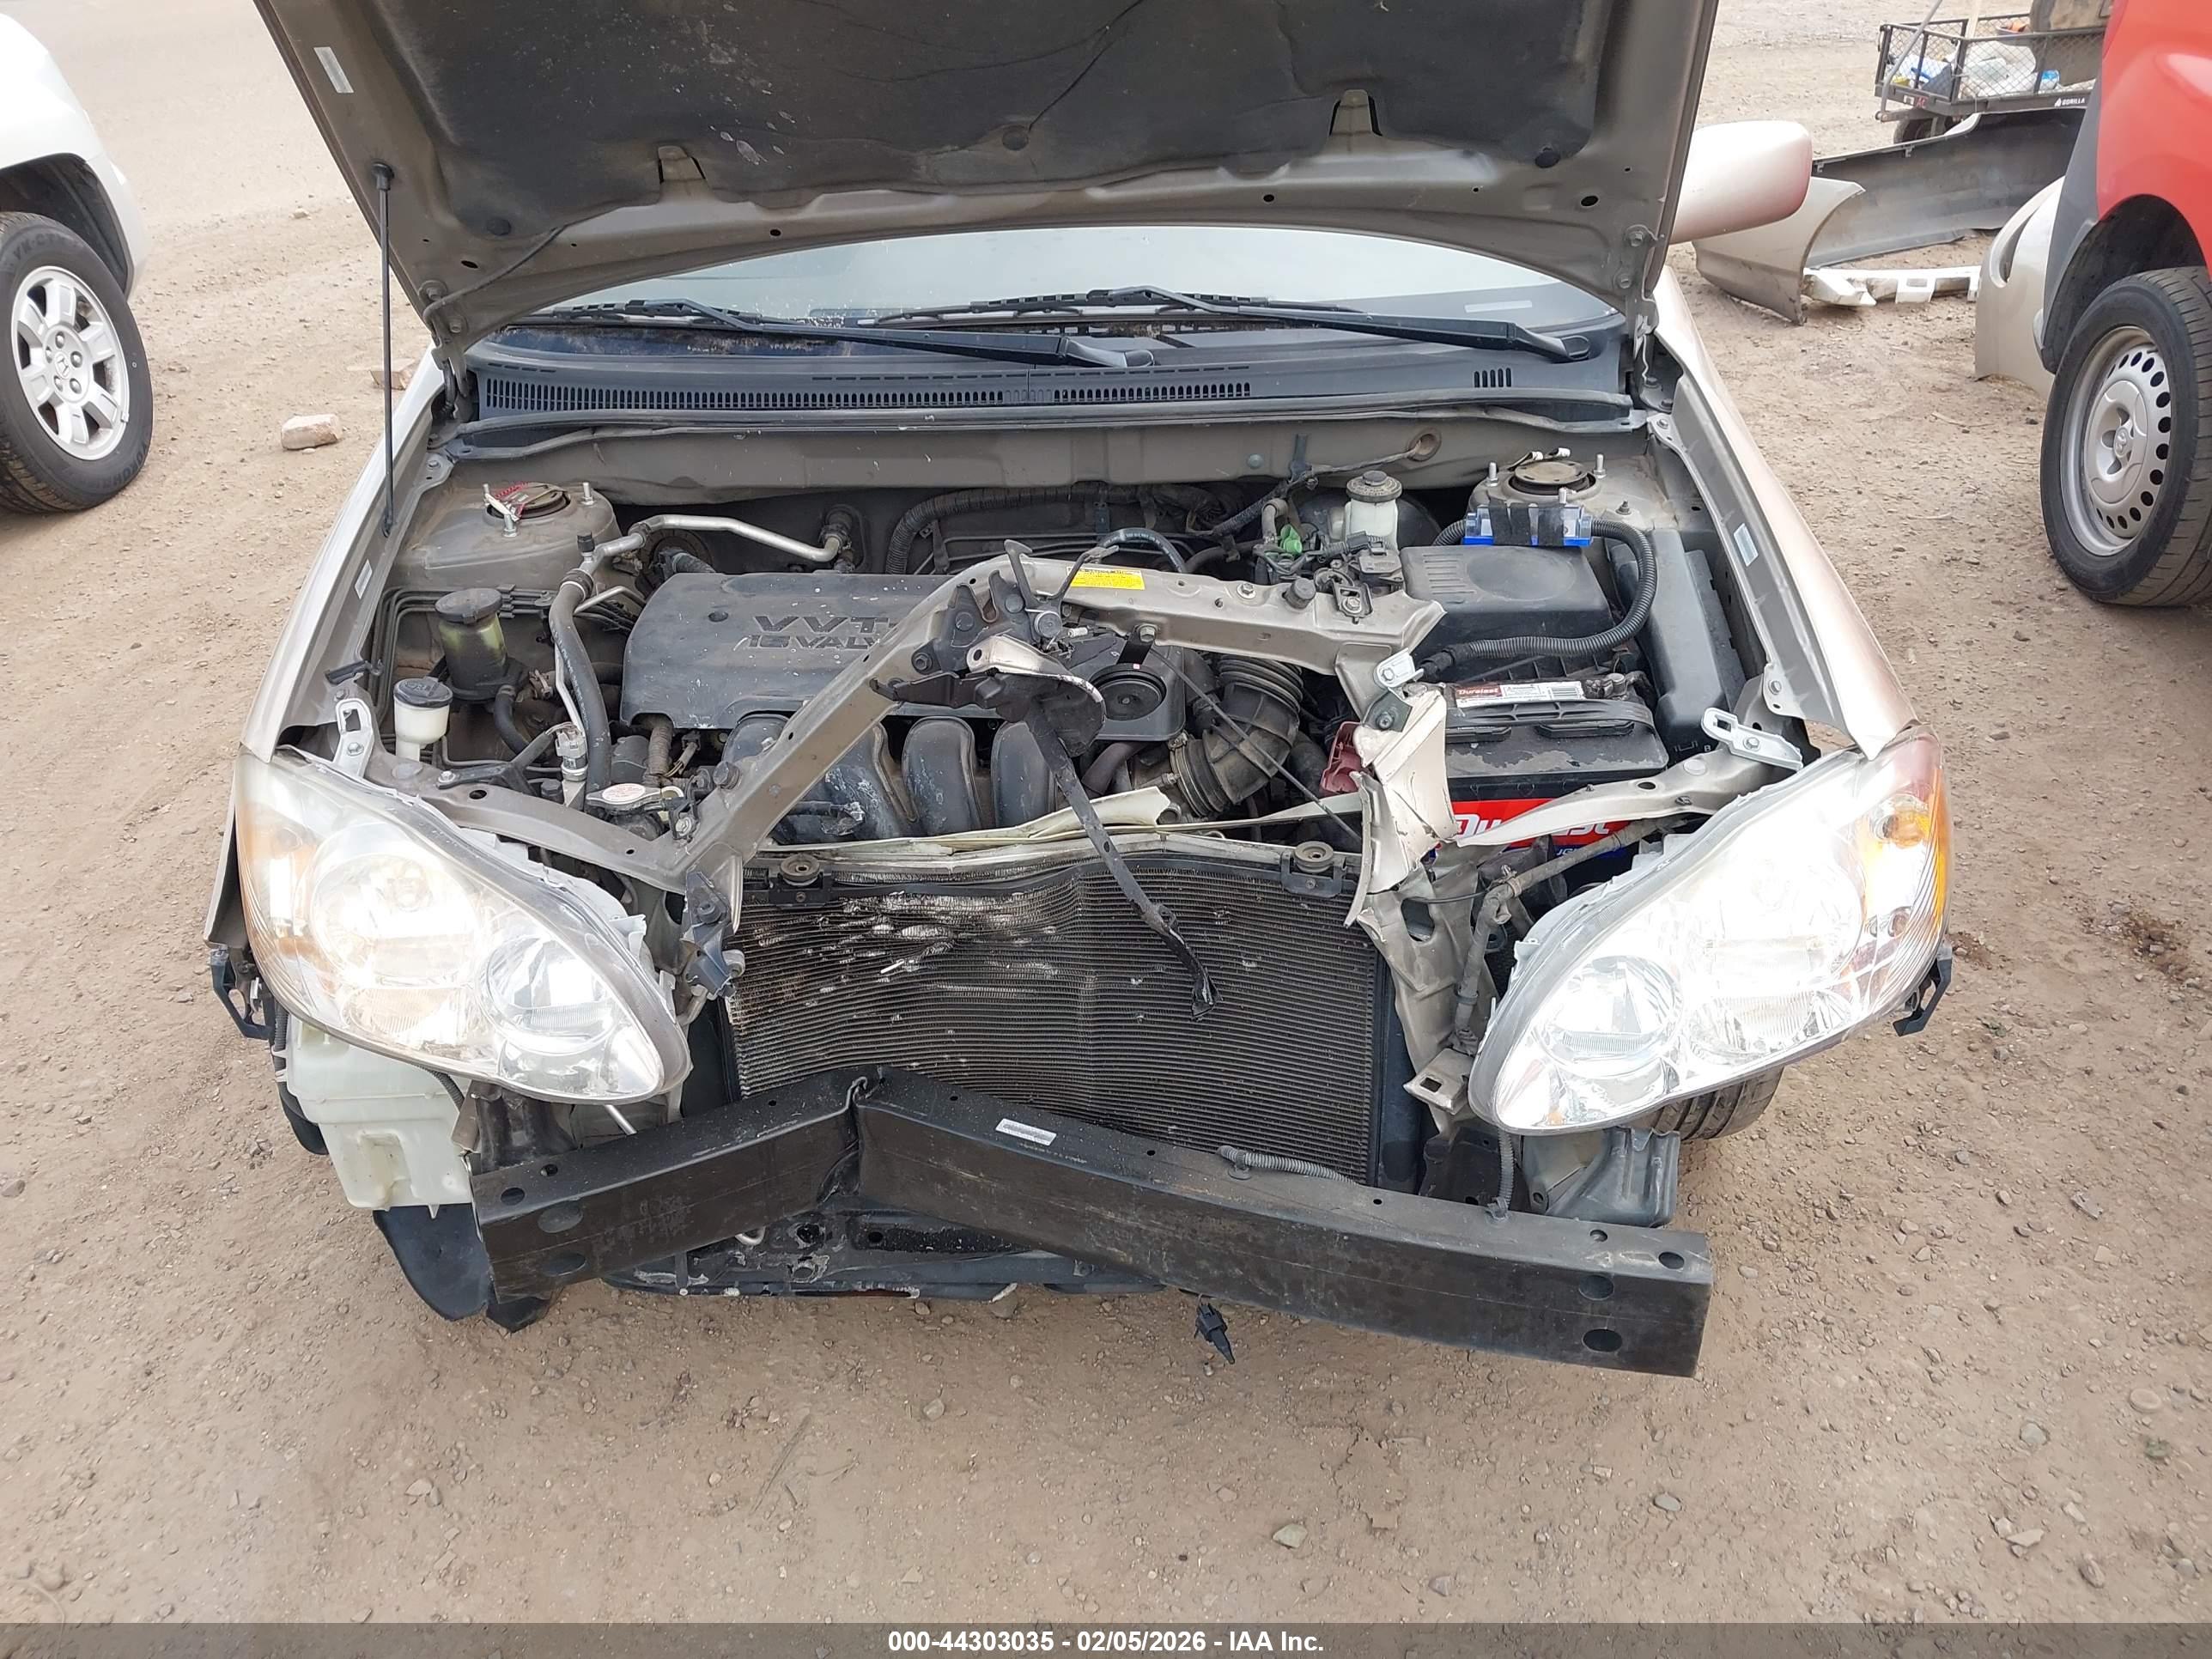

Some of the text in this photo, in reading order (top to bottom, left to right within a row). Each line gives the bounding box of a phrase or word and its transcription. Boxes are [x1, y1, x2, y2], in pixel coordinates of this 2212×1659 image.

[2062, 97, 2086, 106] GORILLA
[795, 635, 878, 649] VALV
[1456, 687, 1499, 696] Duralast
